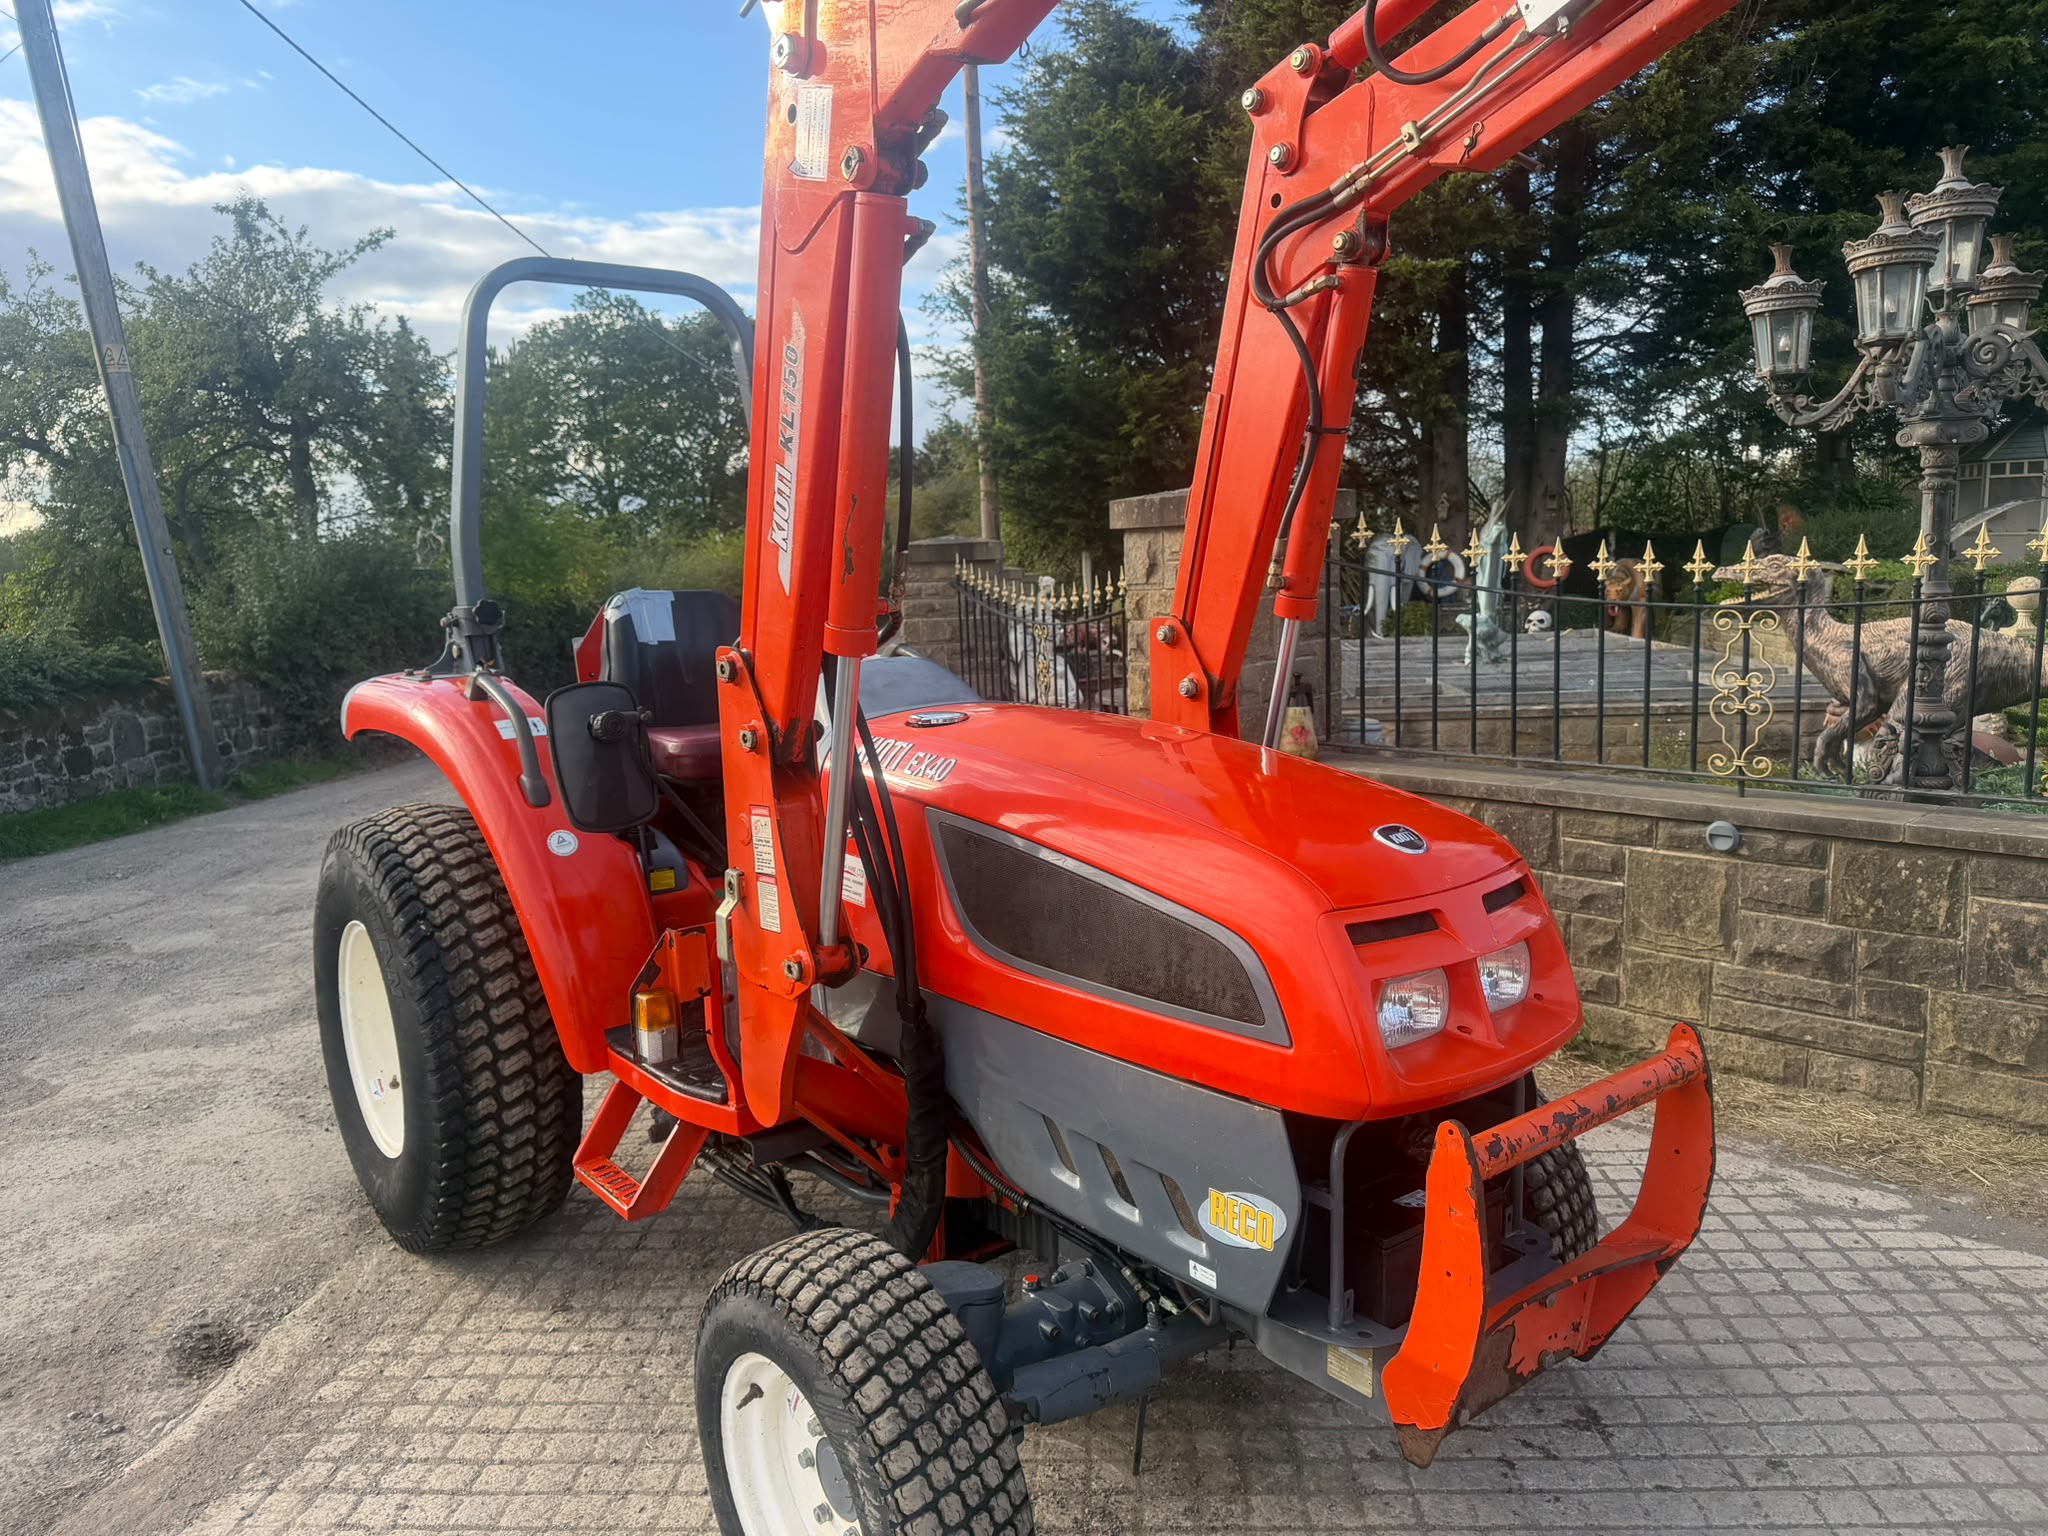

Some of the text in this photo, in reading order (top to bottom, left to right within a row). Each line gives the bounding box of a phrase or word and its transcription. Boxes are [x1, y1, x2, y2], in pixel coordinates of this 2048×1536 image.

[769, 461, 793, 553] KIOTI
[903, 751, 958, 782] EX40
[1389, 831, 1418, 845] KIOTI
[1209, 1188, 1274, 1251] RECO
